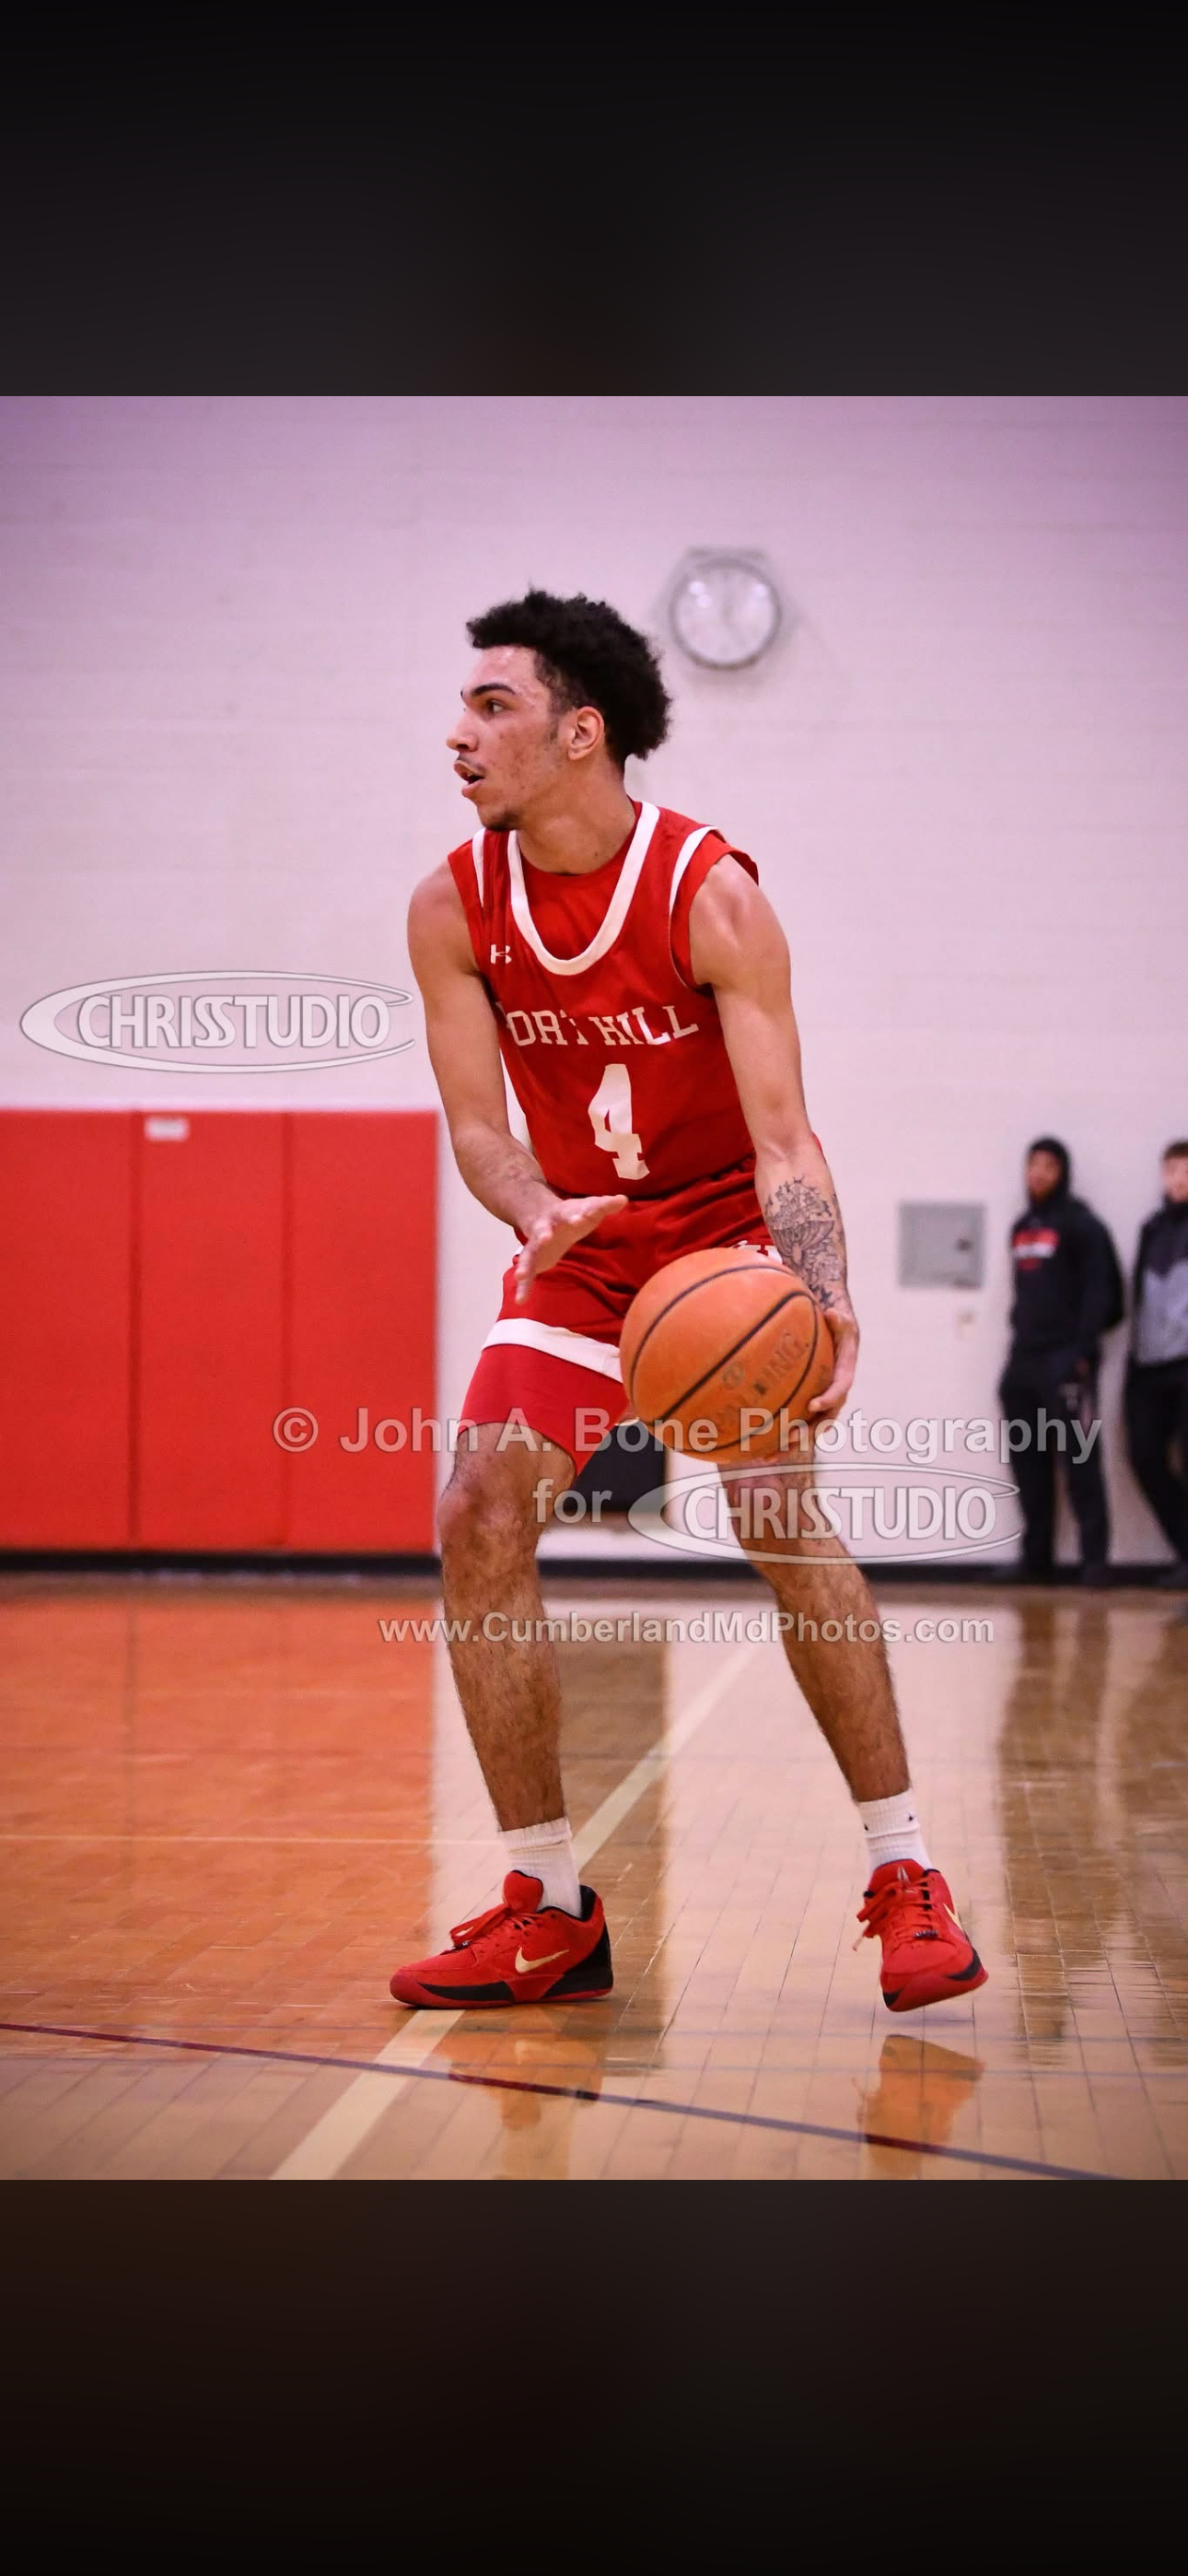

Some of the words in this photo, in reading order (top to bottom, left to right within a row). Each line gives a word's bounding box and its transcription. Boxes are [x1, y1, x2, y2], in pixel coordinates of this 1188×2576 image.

[497, 1002, 589, 1047] OR
[588, 1005, 699, 1047] HILL
[588, 1063, 650, 1180] 4
